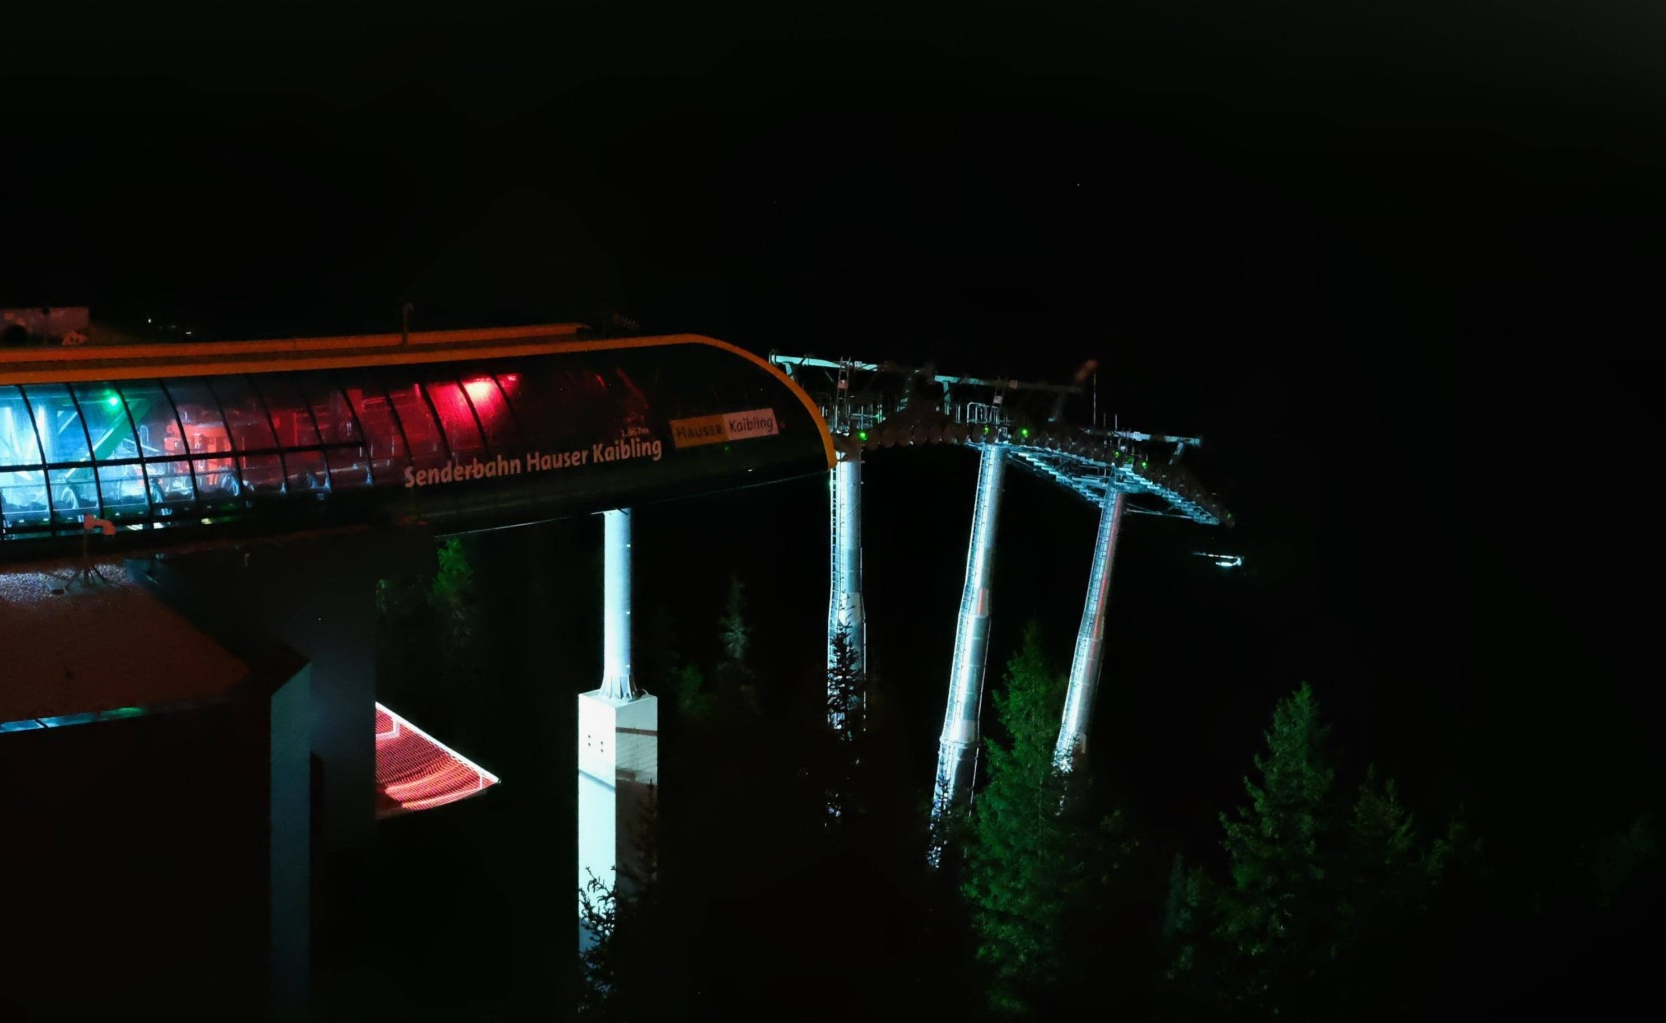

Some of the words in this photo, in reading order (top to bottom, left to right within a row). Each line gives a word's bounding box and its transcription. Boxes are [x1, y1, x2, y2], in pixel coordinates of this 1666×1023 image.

[676, 424, 723, 440] HAUSER
[729, 416, 774, 433] Kaibling
[404, 454, 522, 488] Senderbahn
[526, 450, 589, 474] Hauser
[592, 437, 663, 464] Kaibling
